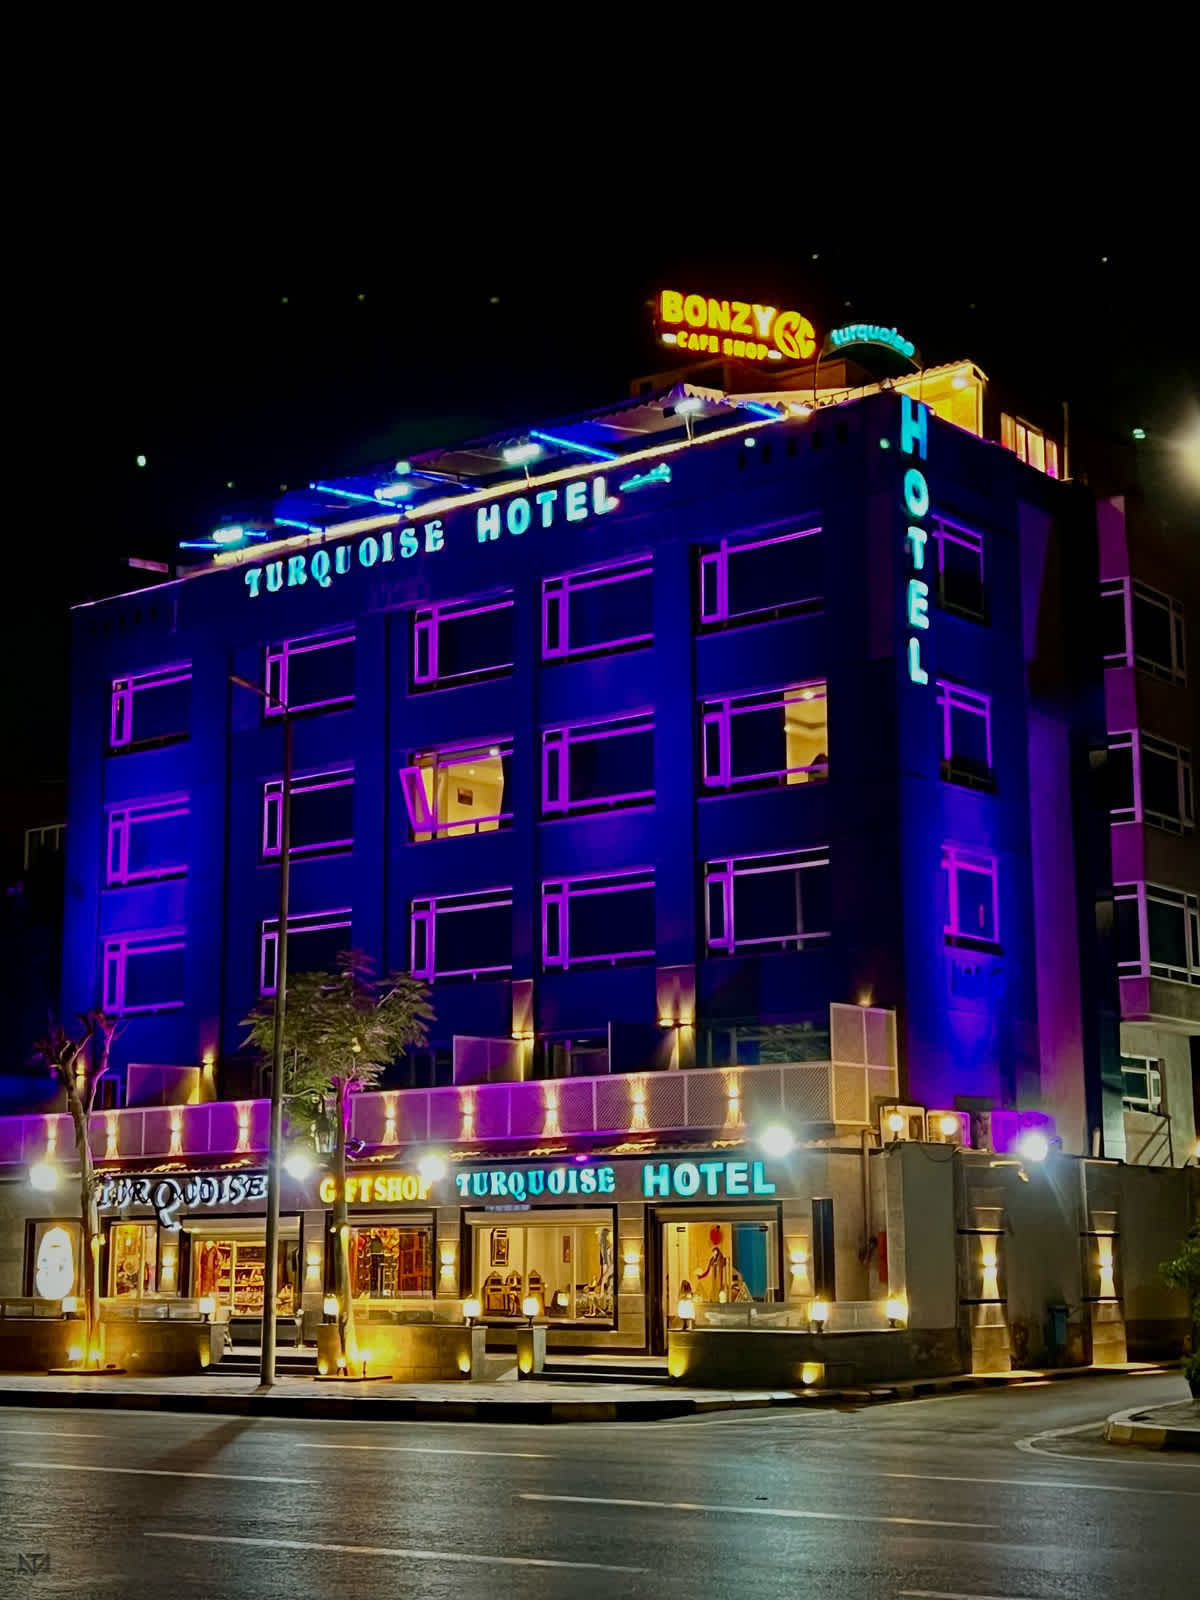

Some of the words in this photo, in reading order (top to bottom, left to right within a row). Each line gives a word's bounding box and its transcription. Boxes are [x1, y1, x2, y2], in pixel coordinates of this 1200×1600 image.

[661, 289, 777, 337] BONZY
[723, 338, 769, 360] SHOP
[244, 520, 446, 598] TURQUOISE
[477, 476, 620, 543] HOTEL
[901, 396, 929, 684] HOTEL
[319, 1177, 374, 1203] GFT
[455, 1168, 616, 1201] TURQUOISE
[643, 1161, 776, 1197] HOTEL
